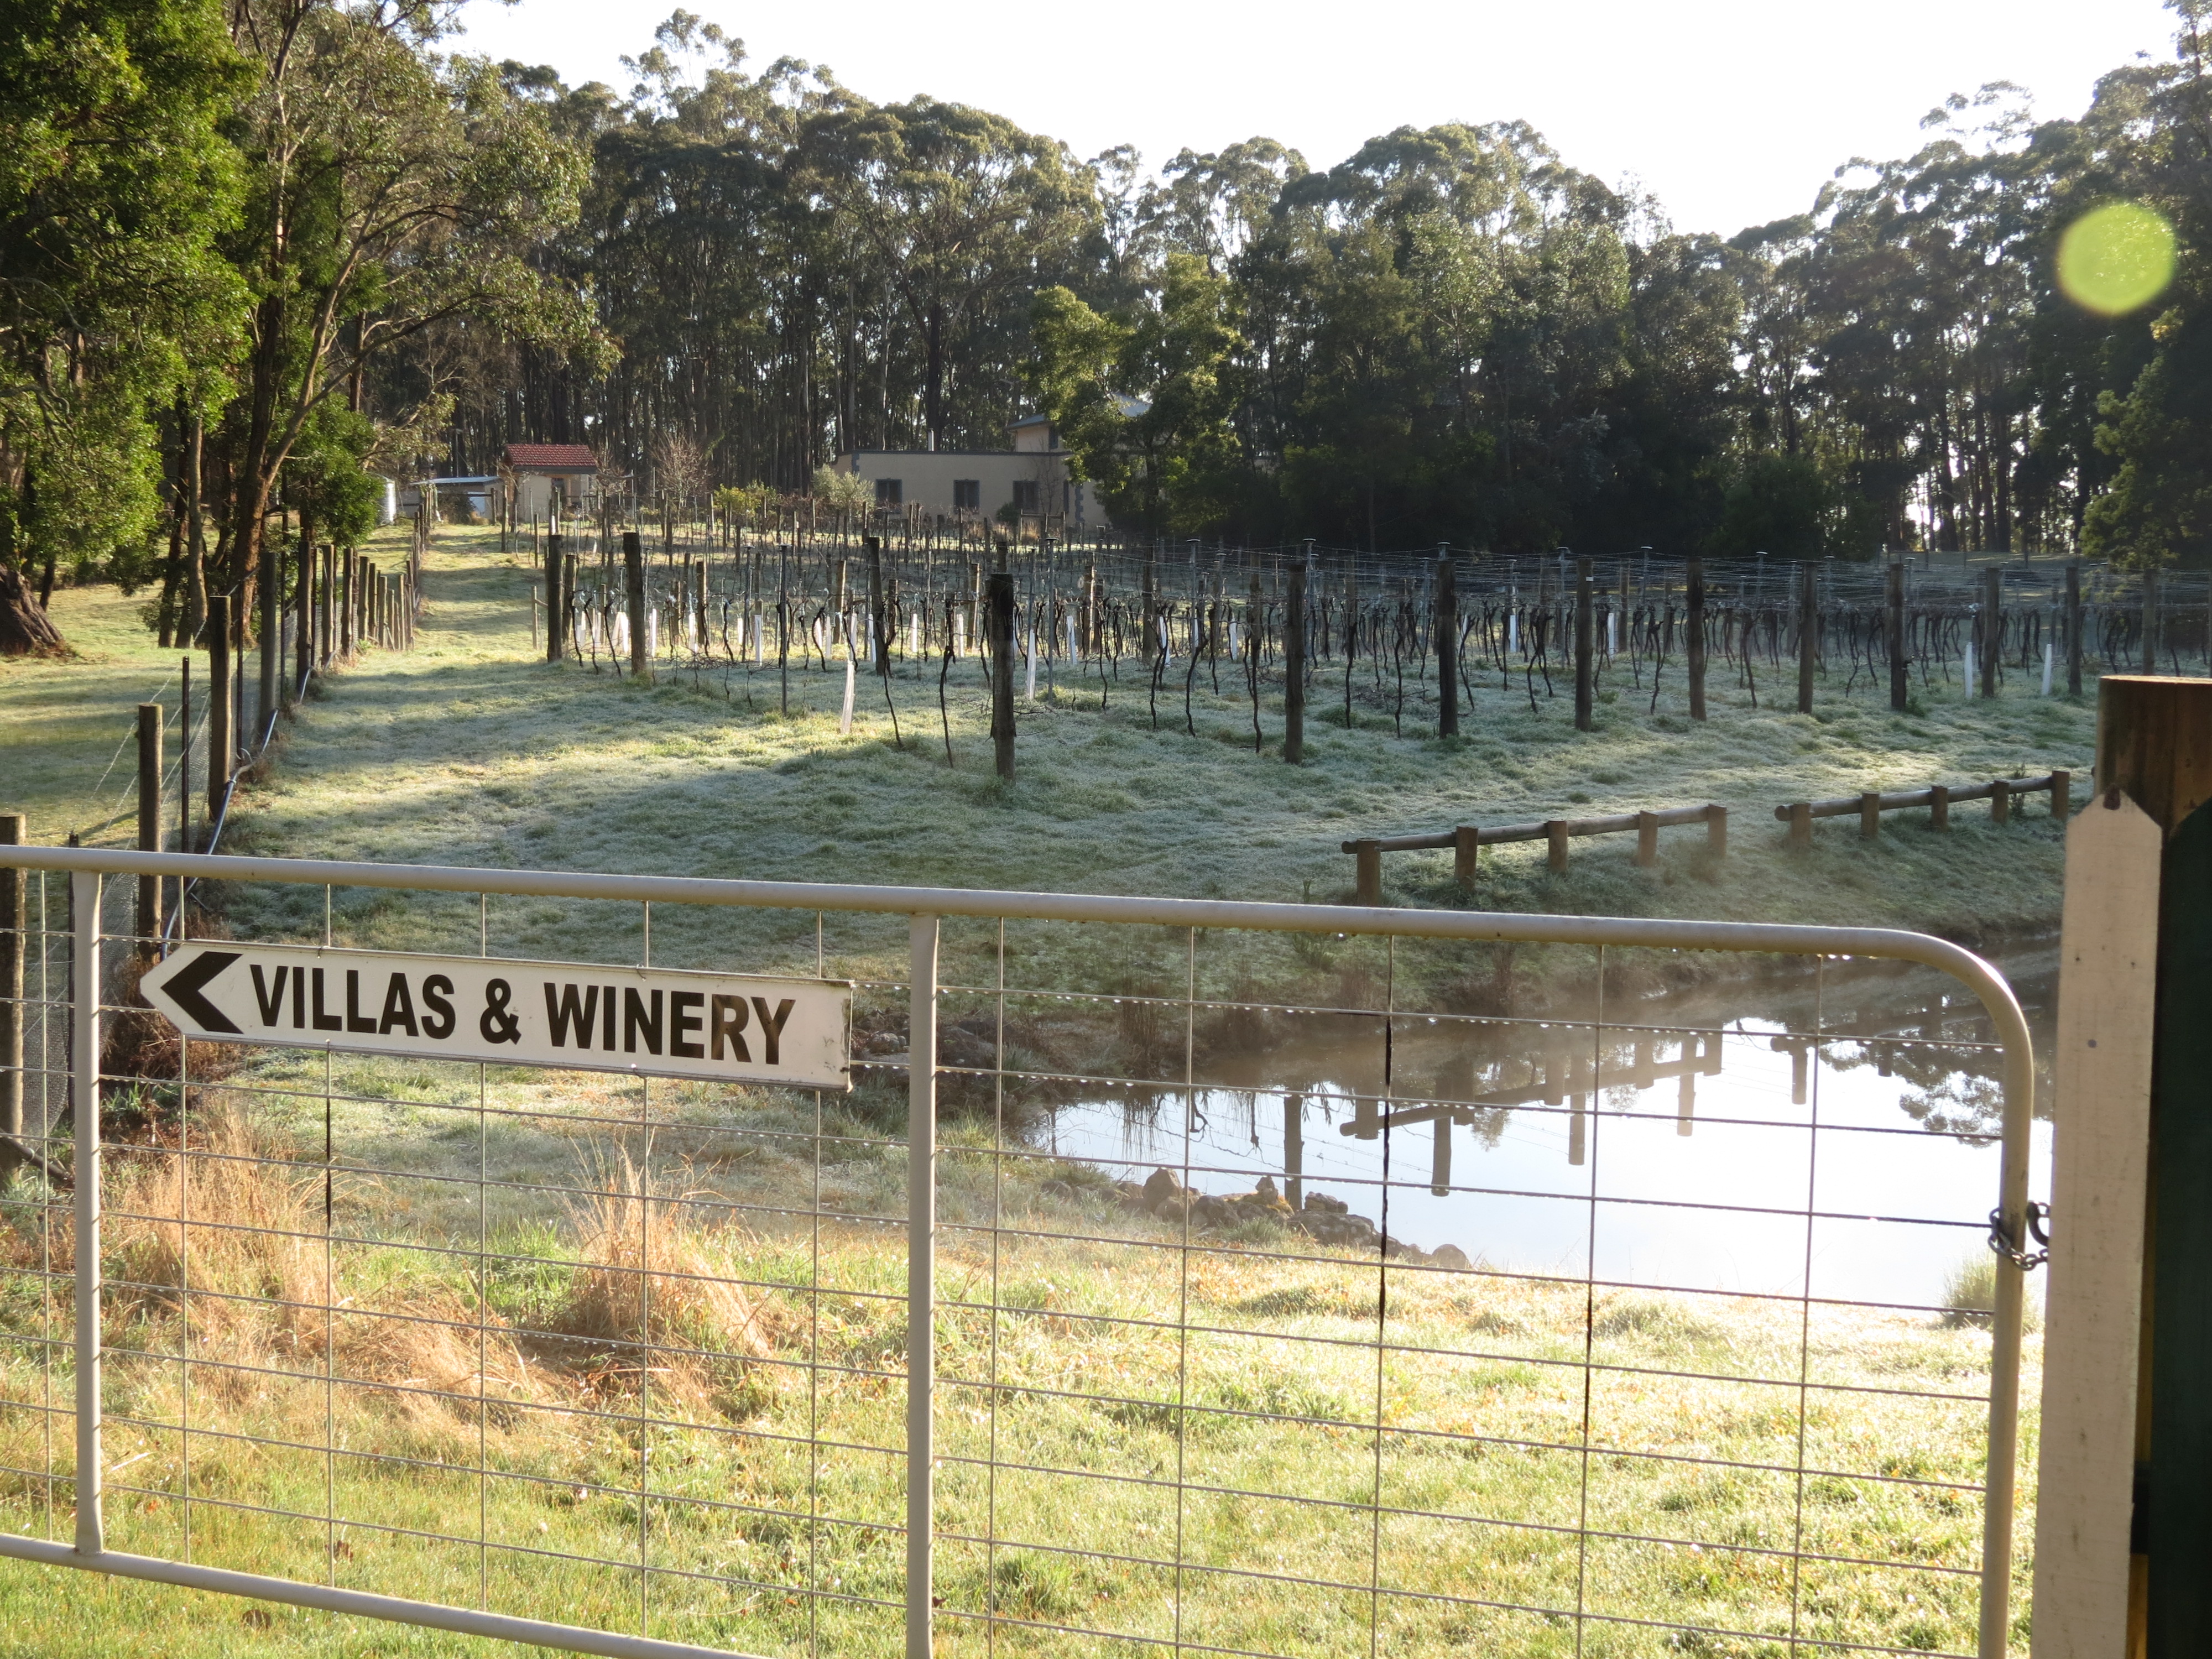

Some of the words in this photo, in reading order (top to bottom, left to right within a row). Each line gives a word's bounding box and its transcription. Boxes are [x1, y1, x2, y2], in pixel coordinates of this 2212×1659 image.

[249, 964, 456, 1040] VILLAS
[479, 978, 521, 1045] &
[544, 982, 796, 1065] WINERY
